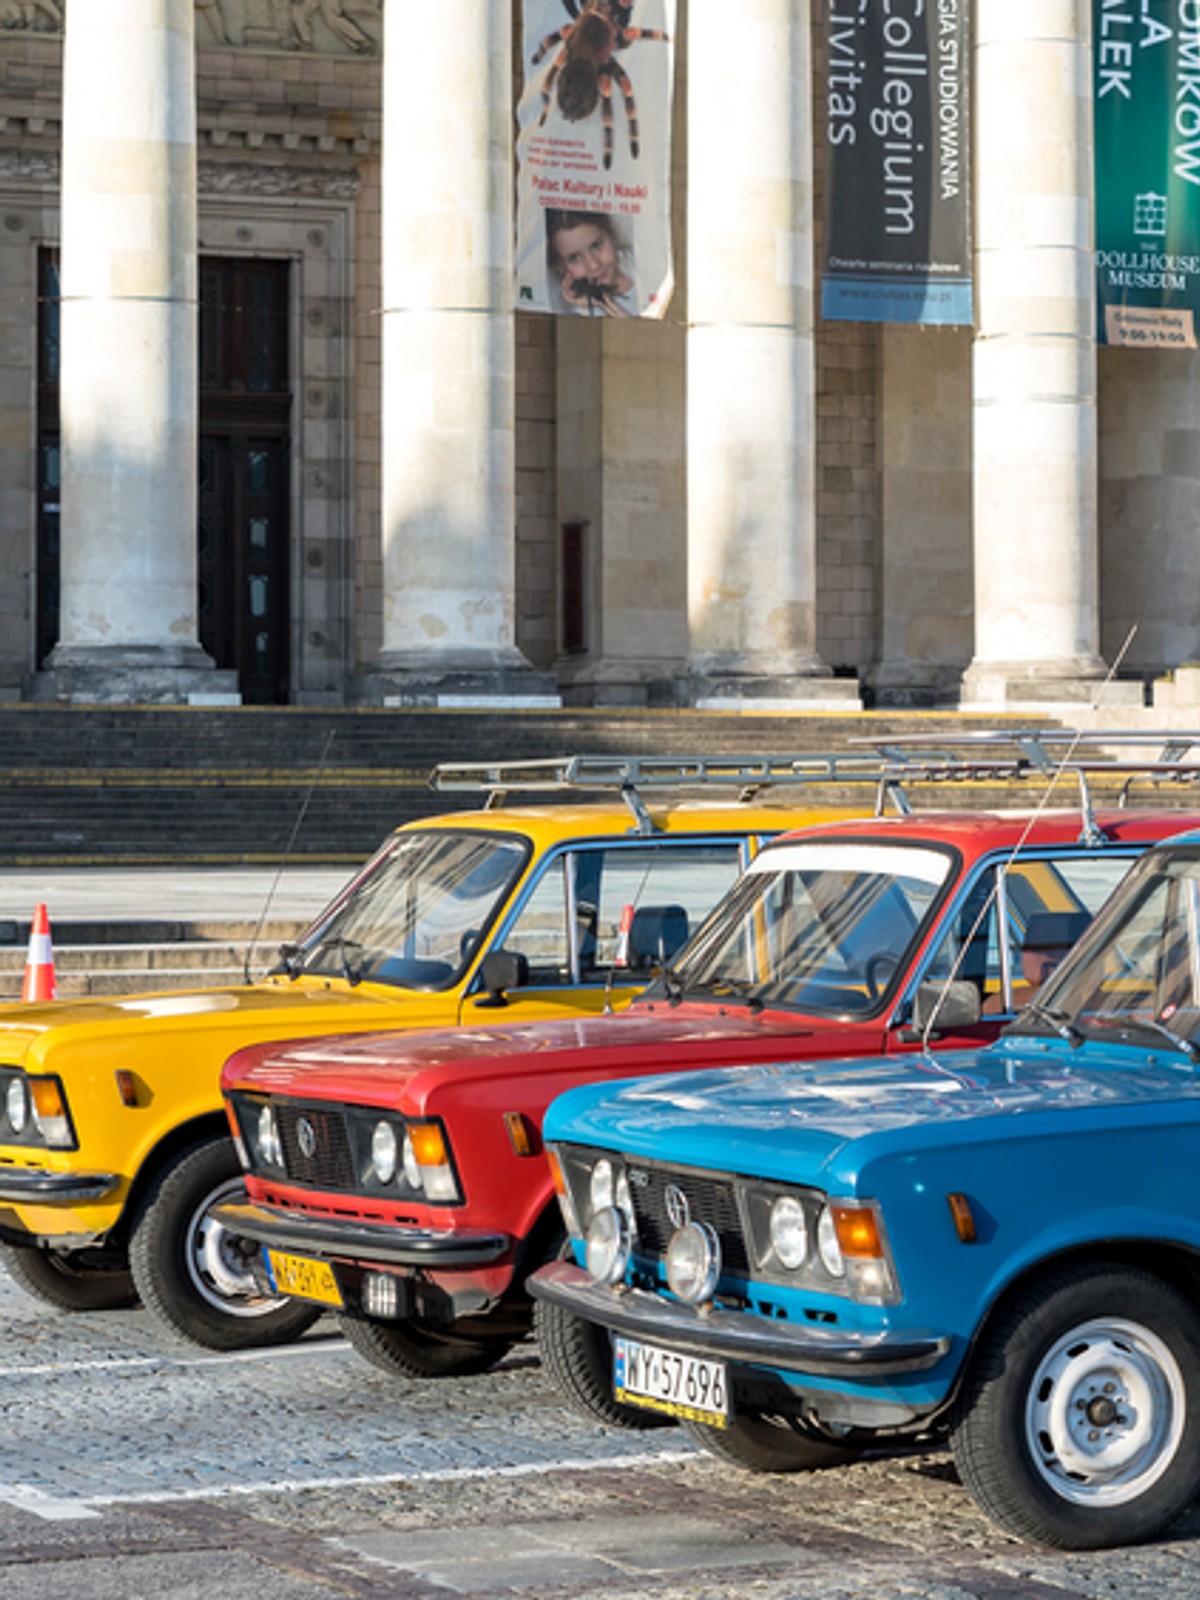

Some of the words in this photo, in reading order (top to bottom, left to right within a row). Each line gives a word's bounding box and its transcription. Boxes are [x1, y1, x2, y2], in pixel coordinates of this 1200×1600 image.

[1098, 0, 1133, 99] LEK
[937, 39, 960, 199] STUDIOWANIA
[562, 179, 604, 199] Kultury
[614, 182, 648, 199] Nauki
[1107, 269, 1186, 290] MUSEUM
